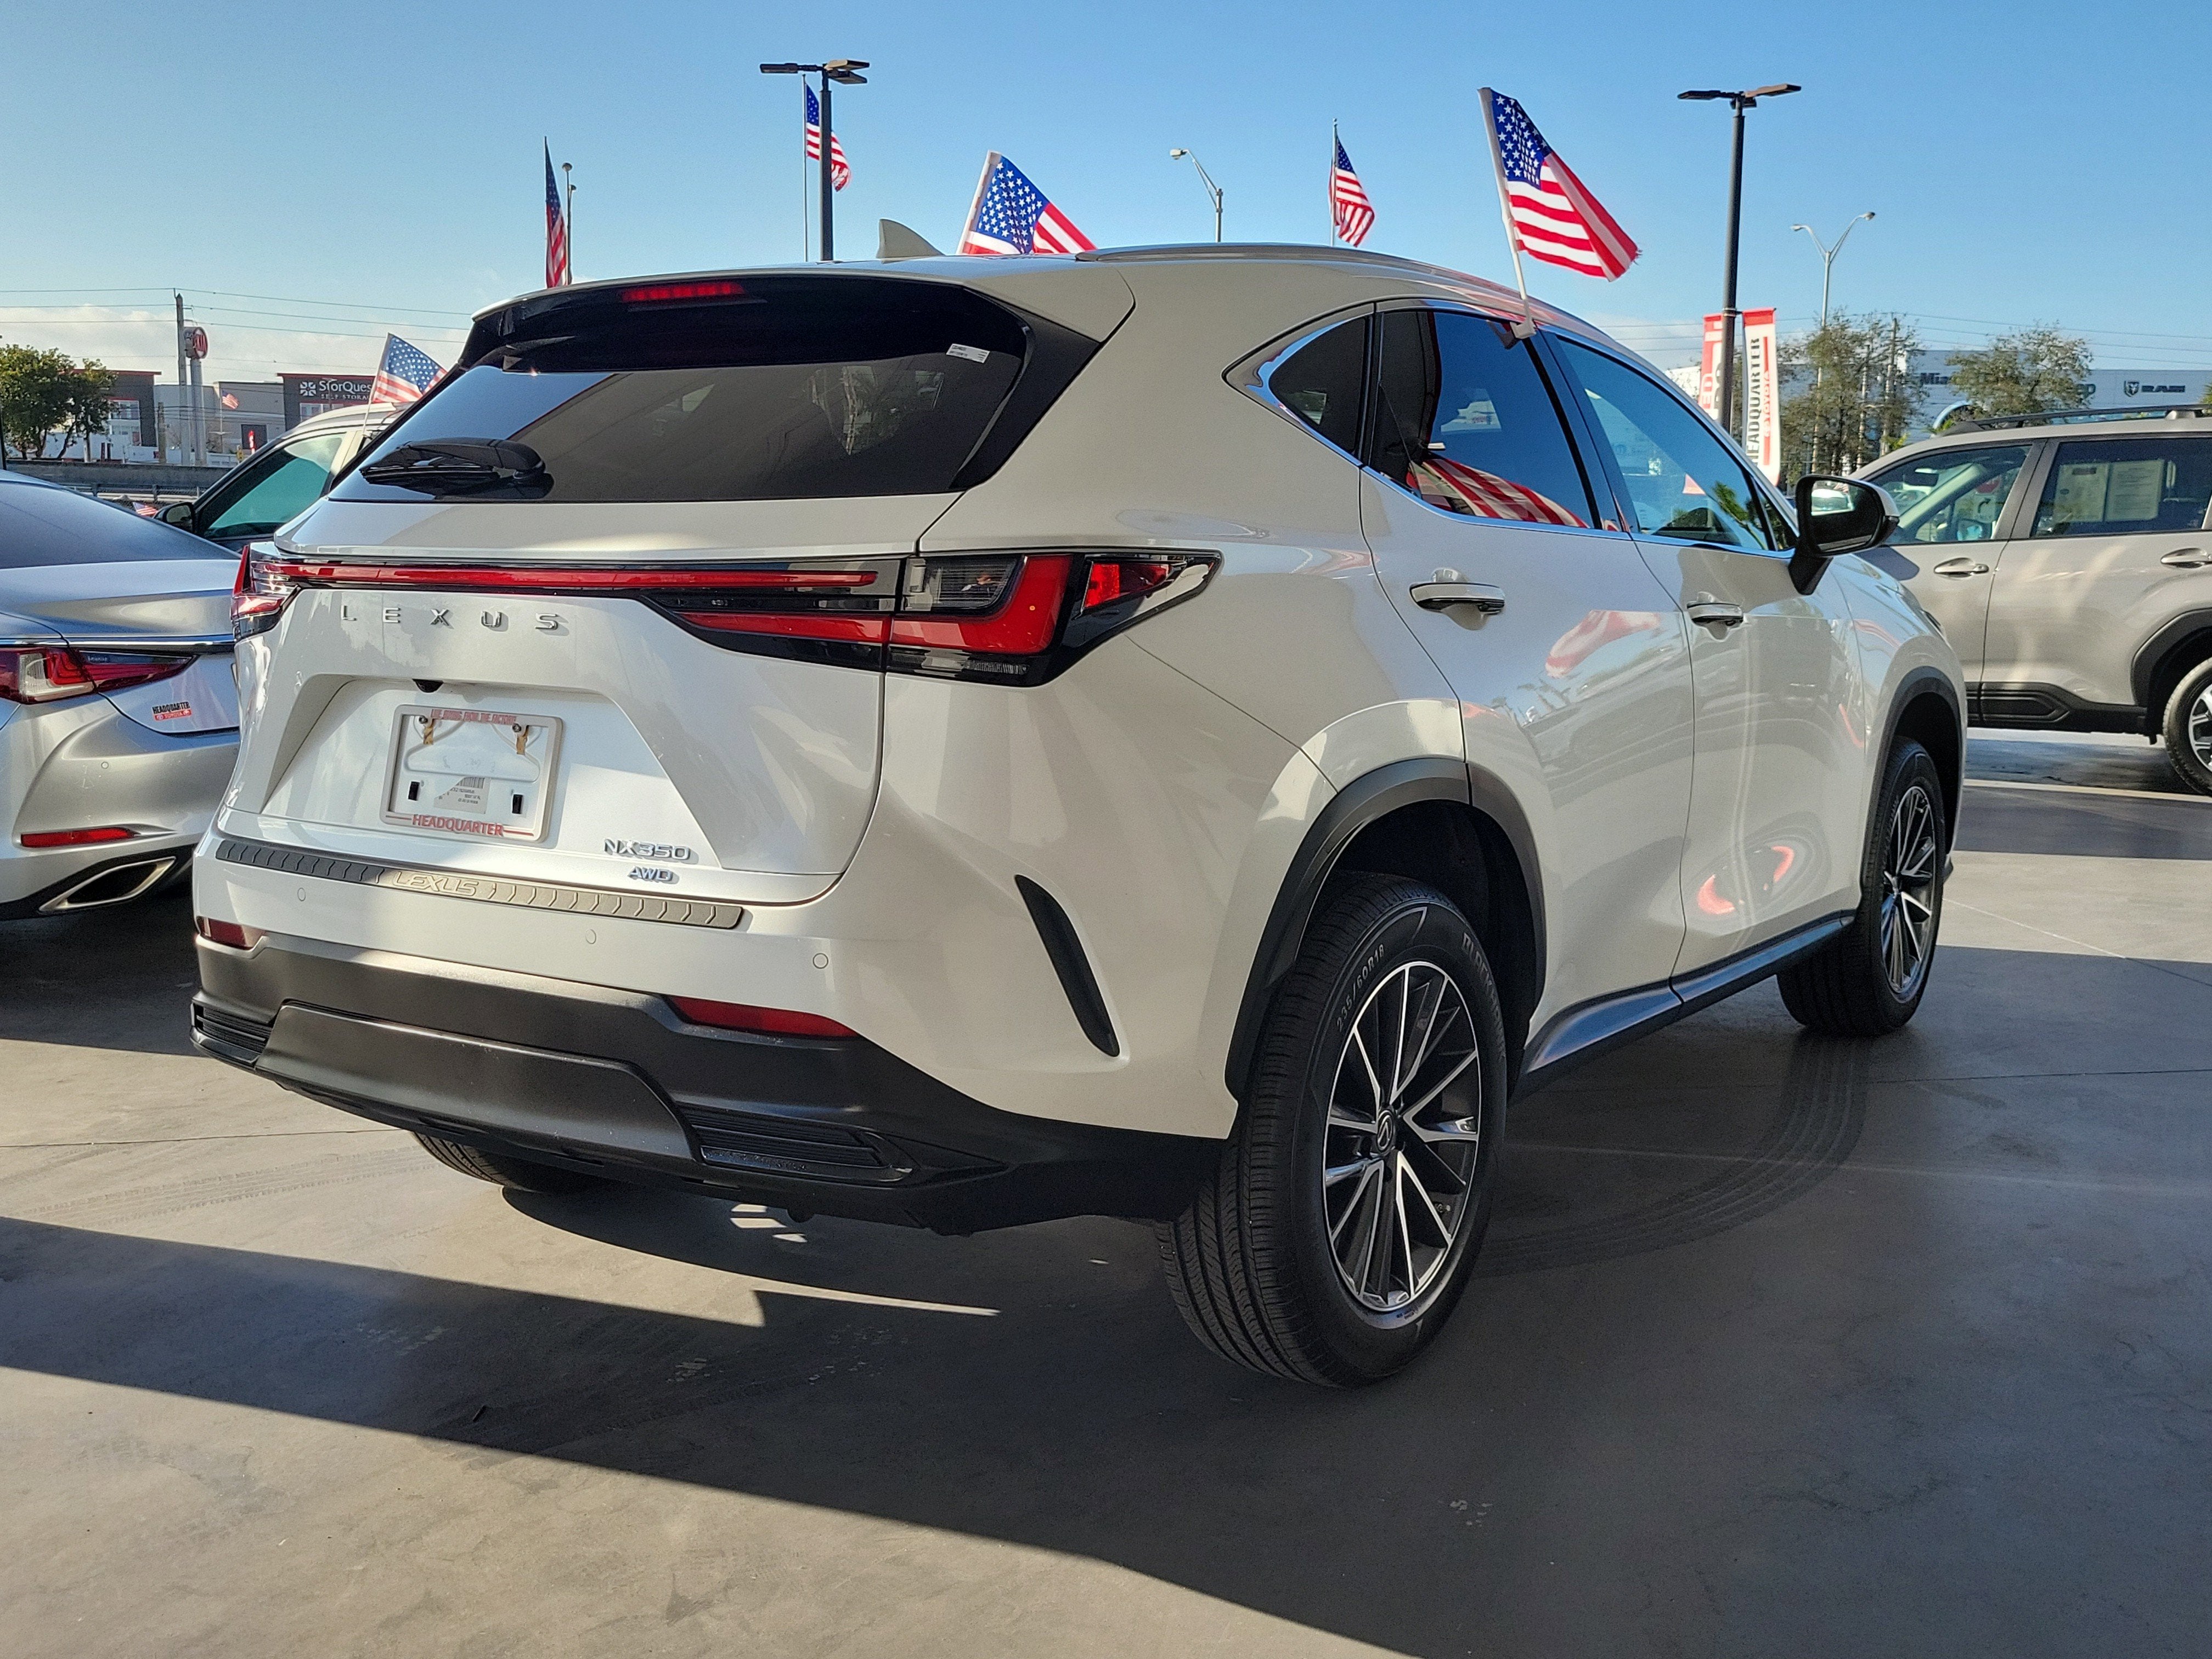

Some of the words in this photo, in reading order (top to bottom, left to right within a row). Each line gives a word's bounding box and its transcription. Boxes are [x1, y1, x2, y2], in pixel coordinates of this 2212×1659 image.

[318, 380, 373, 394] StorQues
[341, 605, 558, 630] LEXUS
[152, 701, 190, 714] HEADQUARTER
[412, 814, 504, 837] HEADQUARTER
[603, 838, 691, 860] NX350
[393, 871, 480, 896] LEXUS
[629, 866, 674, 882] AWD
